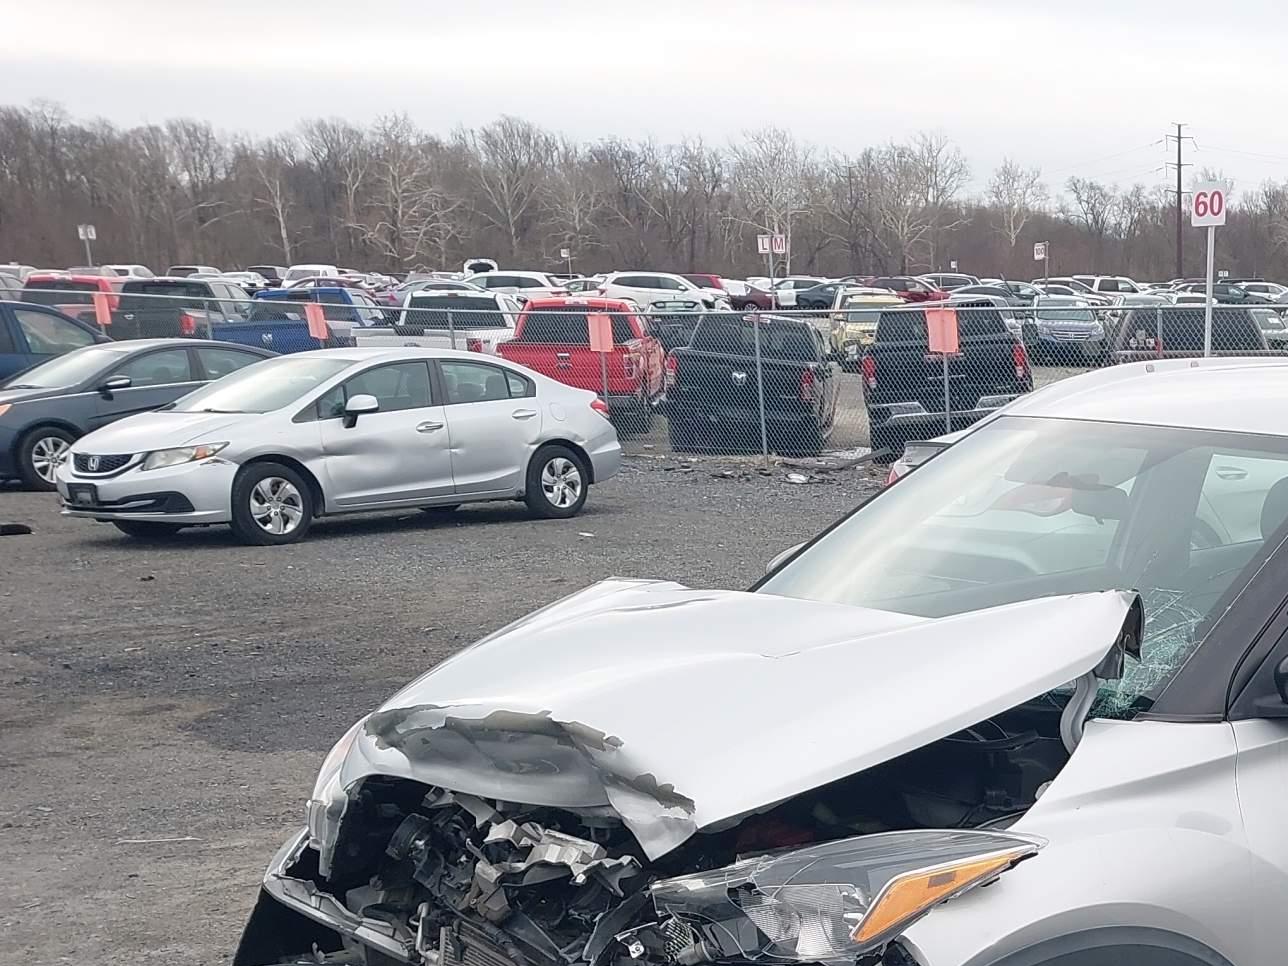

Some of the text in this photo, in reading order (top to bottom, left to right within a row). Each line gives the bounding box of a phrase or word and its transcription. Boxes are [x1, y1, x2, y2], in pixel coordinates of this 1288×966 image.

[1194, 191, 1223, 217] 60
[762, 237, 784, 250] L M
